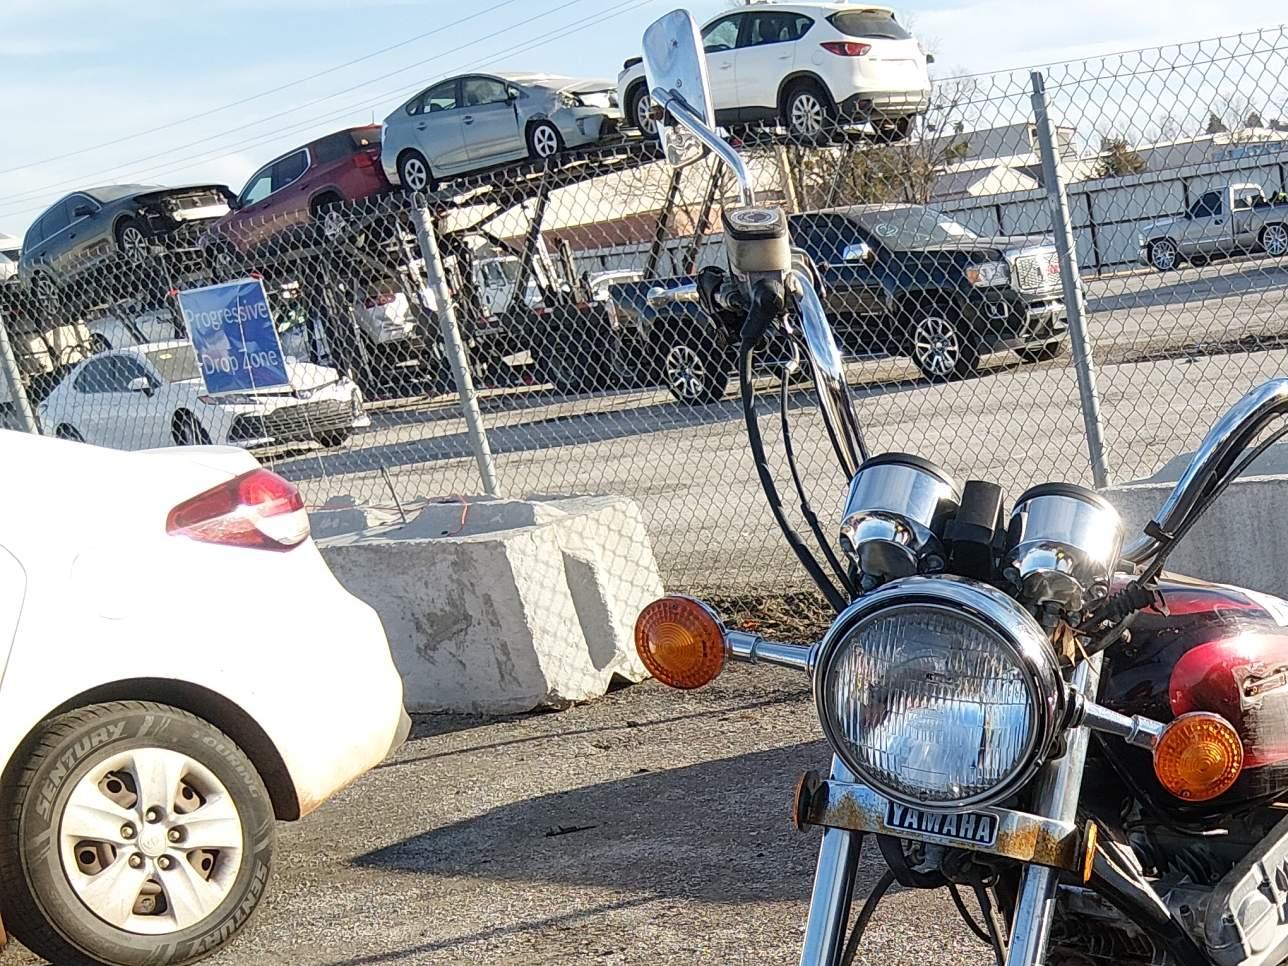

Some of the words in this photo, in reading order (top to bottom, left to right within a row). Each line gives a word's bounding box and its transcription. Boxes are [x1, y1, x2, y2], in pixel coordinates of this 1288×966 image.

[185, 299, 268, 330] Progressive
[202, 354, 238, 375] Drop
[243, 349, 279, 370] Zone
[36, 721, 128, 822] SENTURY
[892, 804, 991, 842] YAMAHA
[186, 858, 270, 959] SENTURY
